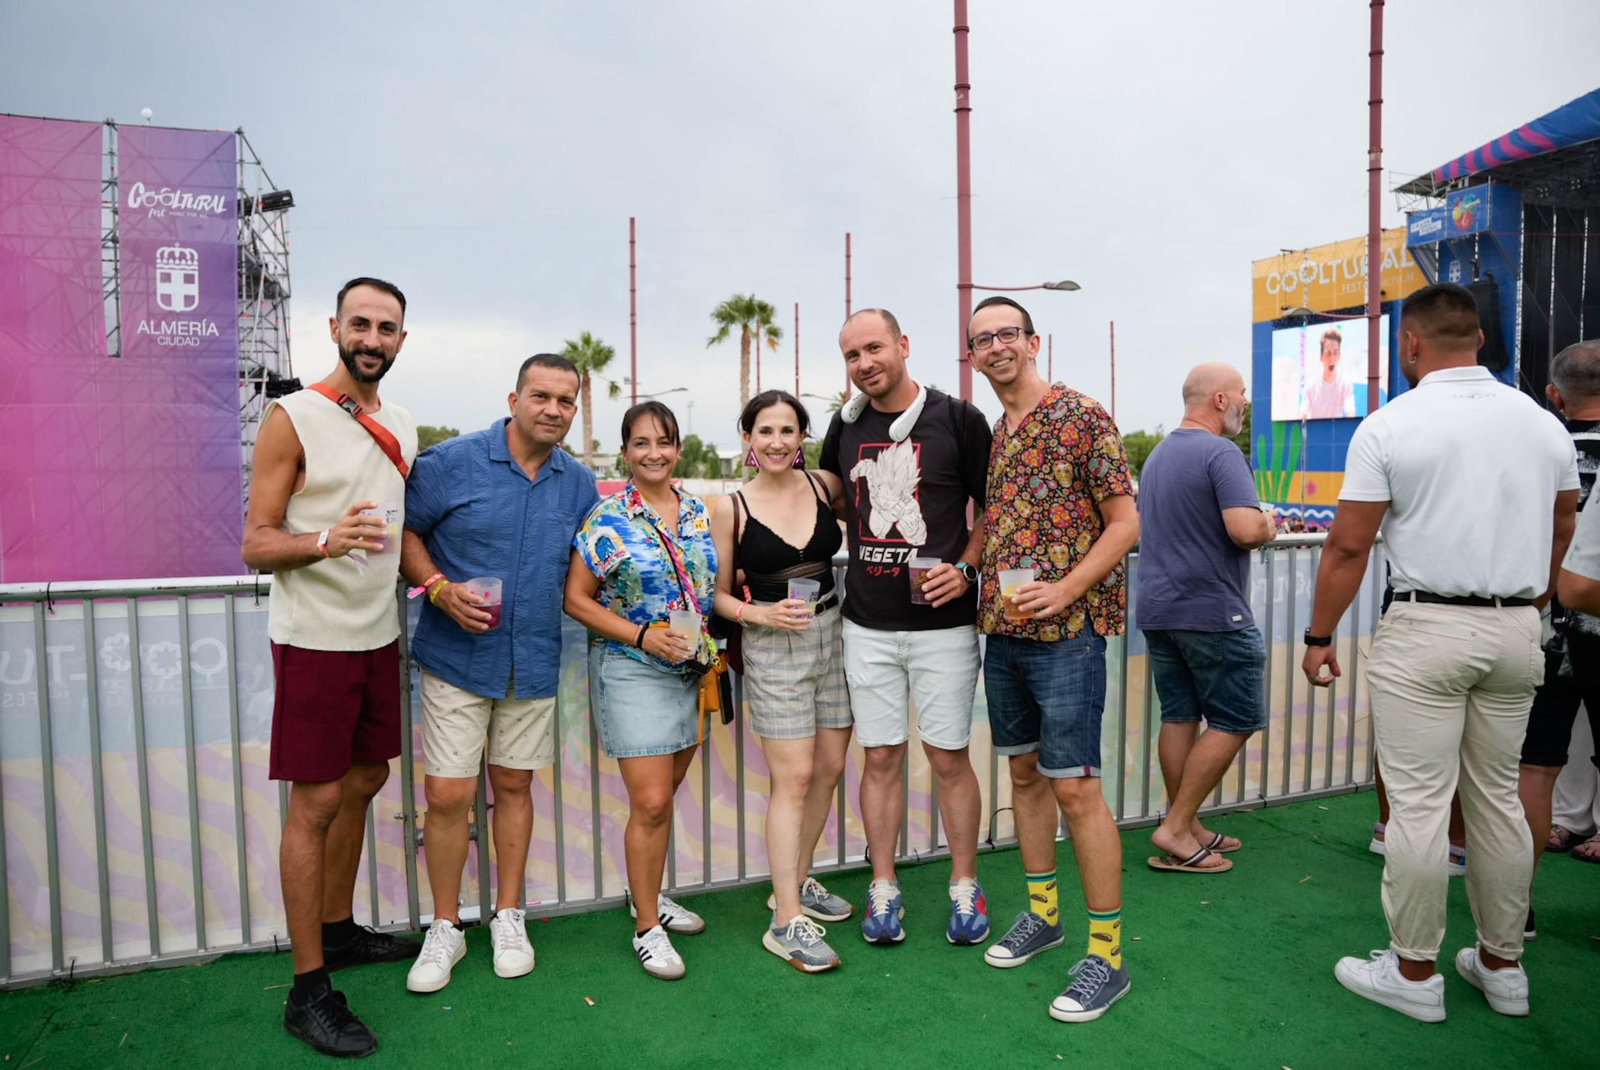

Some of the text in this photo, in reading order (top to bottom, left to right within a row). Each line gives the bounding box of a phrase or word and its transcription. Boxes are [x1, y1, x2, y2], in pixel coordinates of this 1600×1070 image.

[128, 181, 227, 213] COOLTURAL
[137, 319, 219, 337] ALMERÍA
[157, 336, 200, 347] CIUDAD
[859, 544, 918, 564] VEGETA
